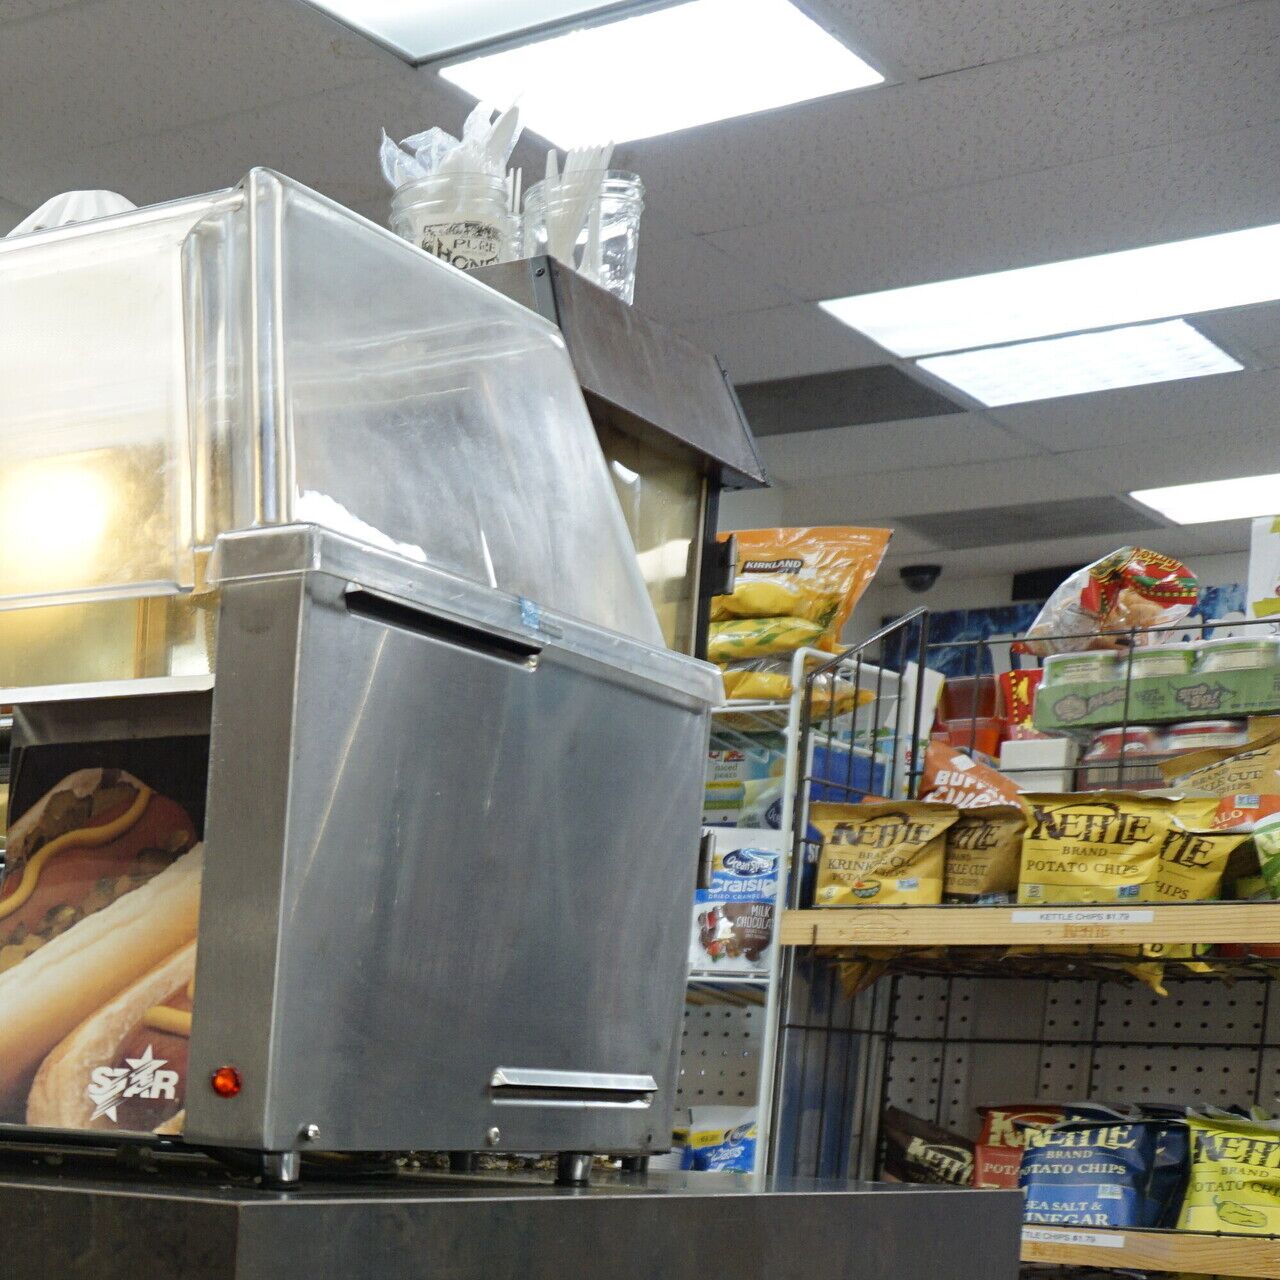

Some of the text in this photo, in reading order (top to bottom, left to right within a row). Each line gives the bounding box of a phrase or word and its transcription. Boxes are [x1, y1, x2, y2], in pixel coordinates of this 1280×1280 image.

[745, 559, 803, 569] KIRKLAND
[1026, 802, 1157, 845] KETTLE
[1061, 846, 1108, 858] BRAND
[1025, 859, 1140, 876] POTATO CHIPS
[751, 904, 772, 917] MILK
[1040, 912, 1073, 921] KETTLE
[1074, 912, 1104, 921] CHIPS
[1046, 1150, 1095, 1159] BRAND
[1077, 1164, 1128, 1175] CHIPS
[1220, 1166, 1270, 1178] BRAND
[1052, 1201, 1089, 1212] SALT
[1089, 1202, 1102, 1212] &
[1042, 1232, 1070, 1242] CHIPS
